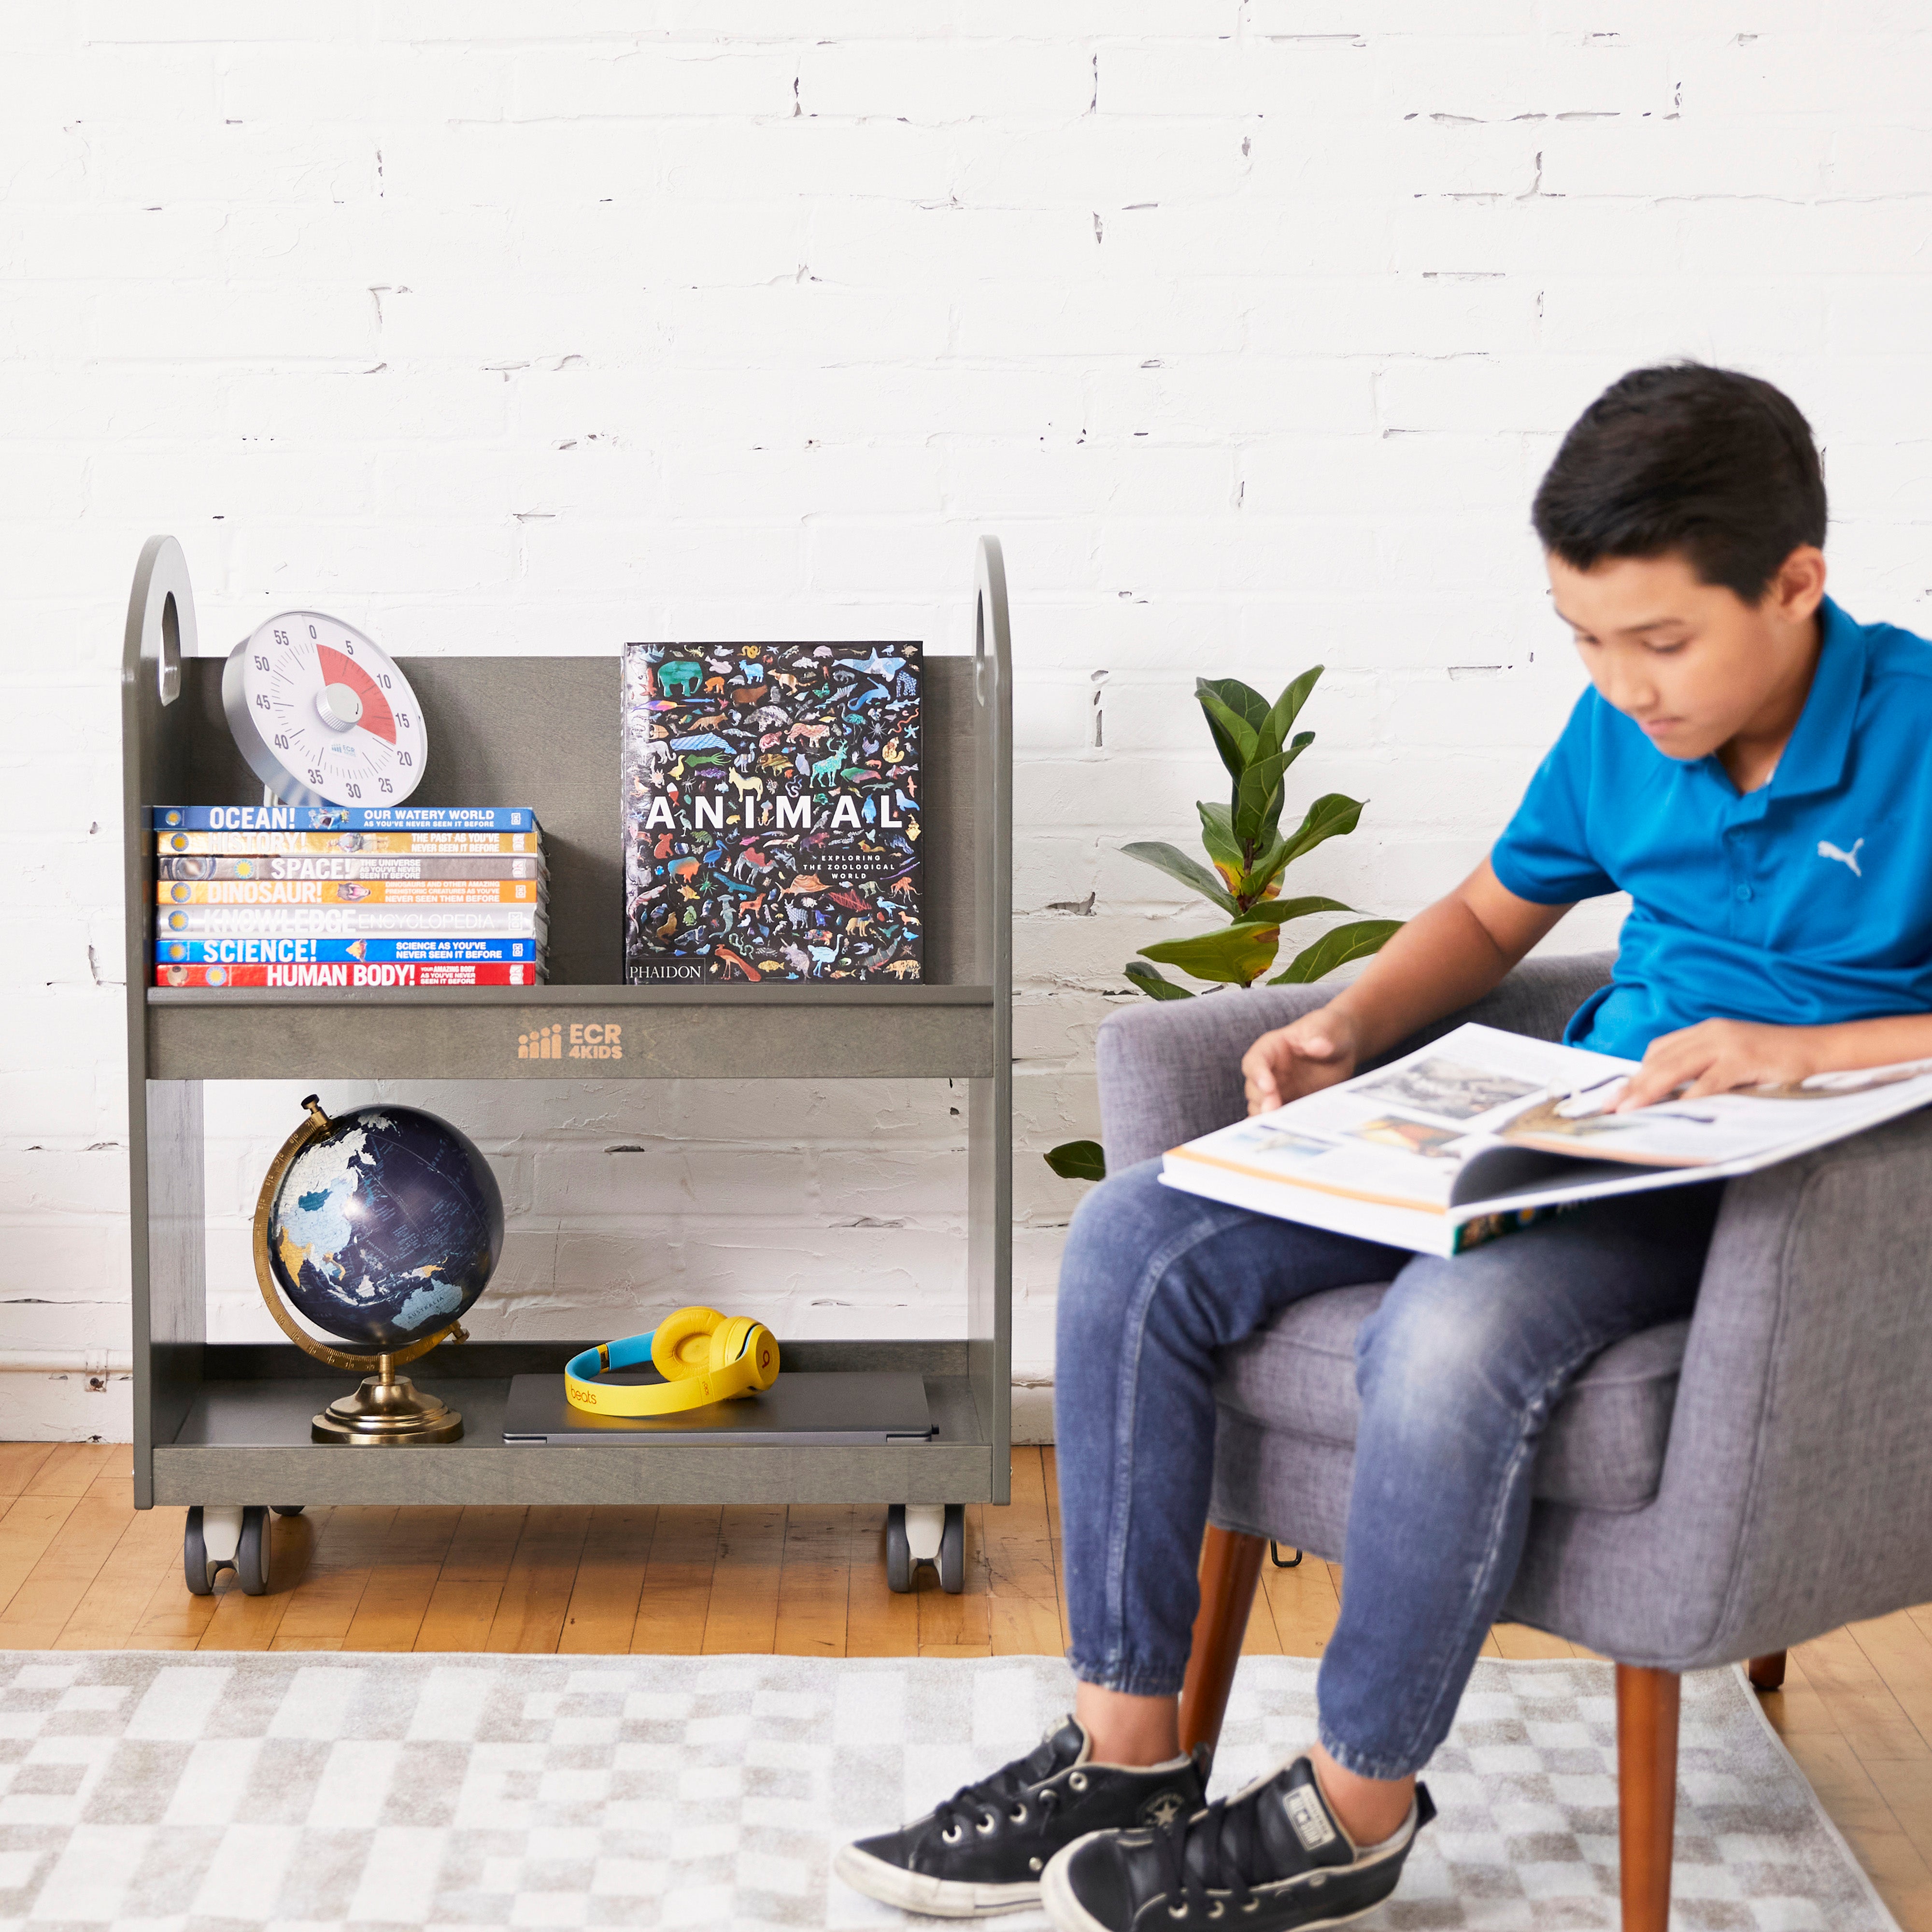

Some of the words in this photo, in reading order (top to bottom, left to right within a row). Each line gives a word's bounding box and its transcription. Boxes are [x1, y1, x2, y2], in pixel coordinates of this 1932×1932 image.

[274, 630, 289, 645] 55
[310, 625, 317, 639] 0
[346, 641, 354, 654] 5
[255, 655, 270, 671] 50
[377, 674, 391, 689] 10
[256, 695, 270, 709] 45
[396, 713, 409, 728] 15
[275, 735, 288, 749] 40
[398, 751, 412, 766] 20
[308, 769, 323, 784] 35
[346, 783, 361, 798] 30
[378, 778, 393, 793] 25
[210, 808, 295, 829] OCEAN!
[364, 810, 392, 820] OUR
[395, 810, 444, 820] WATERY
[449, 810, 494, 820] WORLD
[645, 795, 902, 829] ANIMAL
[208, 832, 306, 853] HISTORY!
[412, 834, 428, 842] THE
[431, 834, 451, 842] PAST
[455, 834, 467, 842] AS
[469, 834, 499, 842] YOU'VE
[412, 844, 437, 852] NEVER
[439, 844, 458, 852] SEEN
[460, 844, 468, 852] IT
[469, 844, 499, 852] BEFORE
[272, 859, 351, 879] SPACE!
[208, 882, 322, 903] DINOSAUR!
[204, 909, 356, 933] KNOWLEDGE
[359, 914, 495, 929] ENCYCLOPEDIA
[203, 940, 317, 962] SCIENCE!
[396, 942, 436, 950] SCIENCE
[438, 942, 450, 950] AS
[452, 942, 486, 950] YOU'VE
[268, 965, 347, 986] HUMAN
[354, 965, 414, 986] BODY!
[629, 966, 701, 979] PHAIDON
[569, 1024, 622, 1044] ECR
[569, 1045, 623, 1059] 4KIDS
[408, 1296, 444, 1320] AUSTRALIA
[570, 1384, 597, 1405] beats
